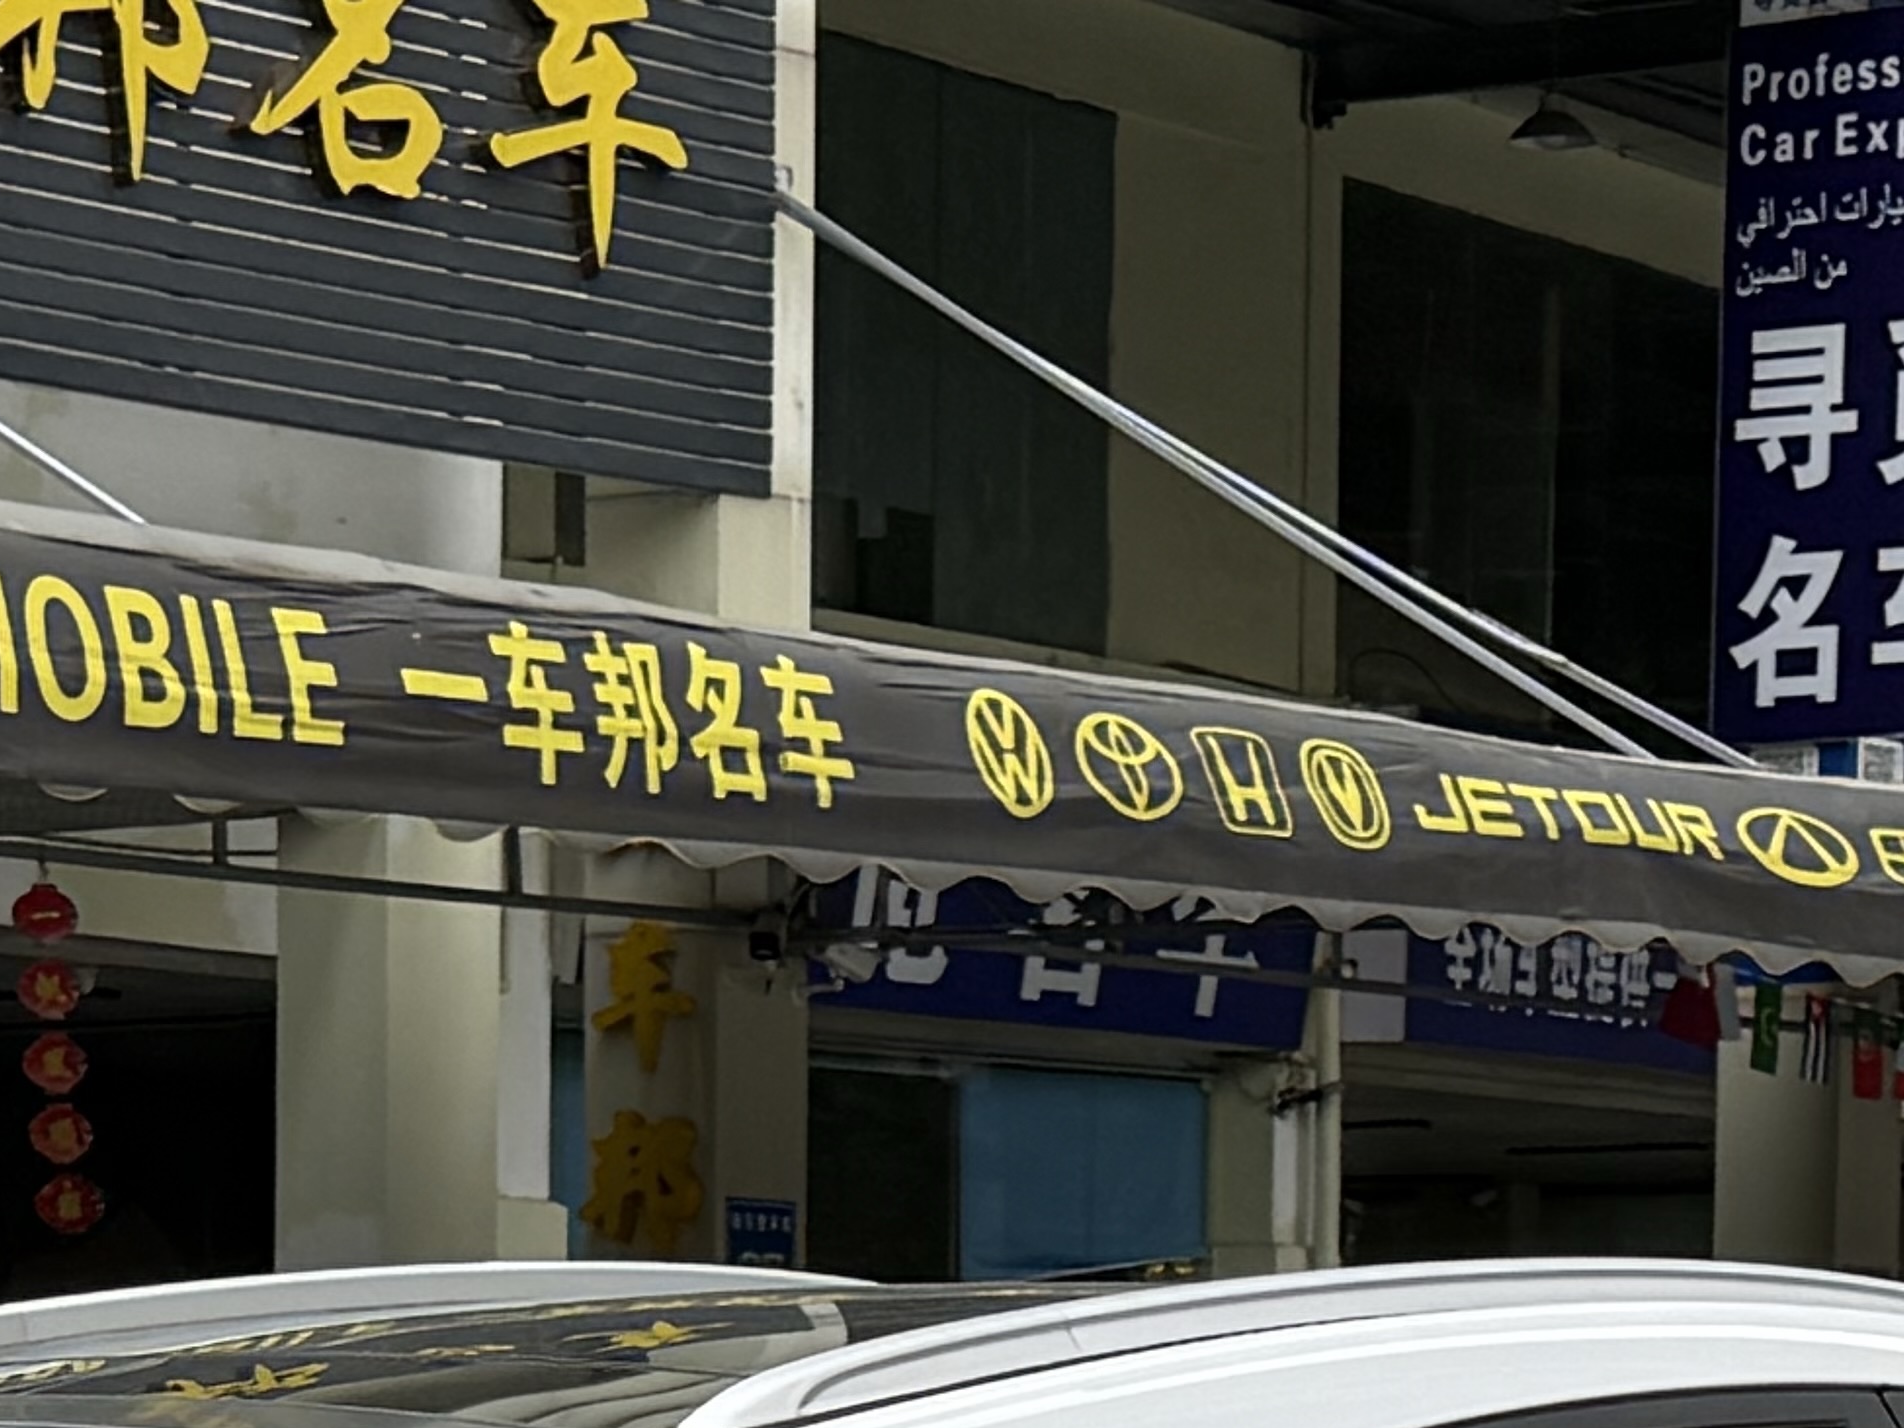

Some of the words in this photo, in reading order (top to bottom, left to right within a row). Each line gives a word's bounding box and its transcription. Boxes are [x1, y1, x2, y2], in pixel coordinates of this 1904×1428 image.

[1740, 121, 1819, 167] Car
[1813, 253, 1848, 289] من
[400, 620, 856, 808] 一车邦名车
[1412, 774, 1724, 860] JETOUR
